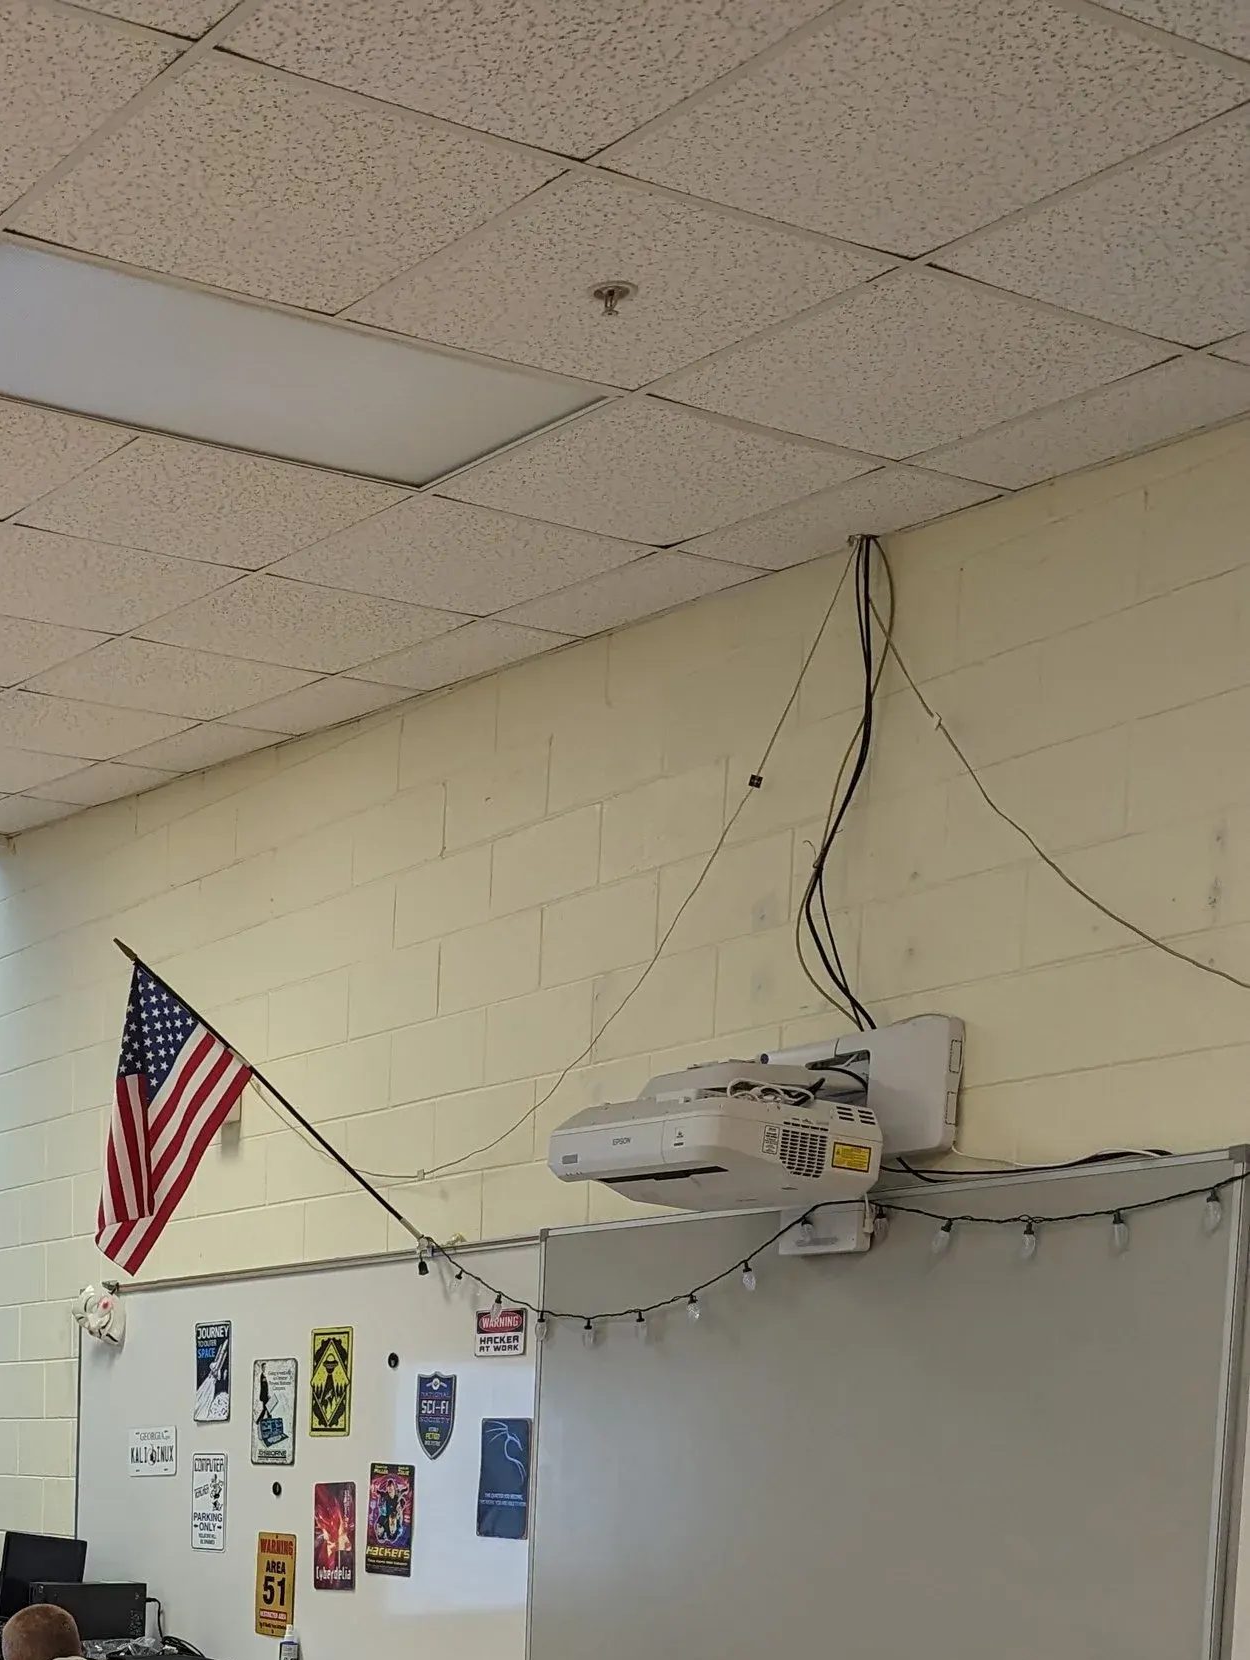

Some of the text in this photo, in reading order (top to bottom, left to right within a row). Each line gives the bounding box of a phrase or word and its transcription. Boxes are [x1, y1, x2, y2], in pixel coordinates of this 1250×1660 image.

[612, 1137, 631, 1146] EPSON
[482, 1315, 519, 1329] WARNING
[197, 1325, 230, 1340] JOURNEY
[479, 1335, 519, 1345] HACKER
[197, 1347, 216, 1359] SPACE
[493, 1344, 519, 1352] WORK
[421, 1400, 449, 1415] SCI-FI
[130, 1446, 148, 1464] KALI
[193, 1512, 223, 1522] PARKING
[199, 1522, 217, 1531] ONLY
[260, 1538, 294, 1556] WARNING
[265, 1560, 286, 1574] AREA
[262, 1575, 286, 1606] 51
